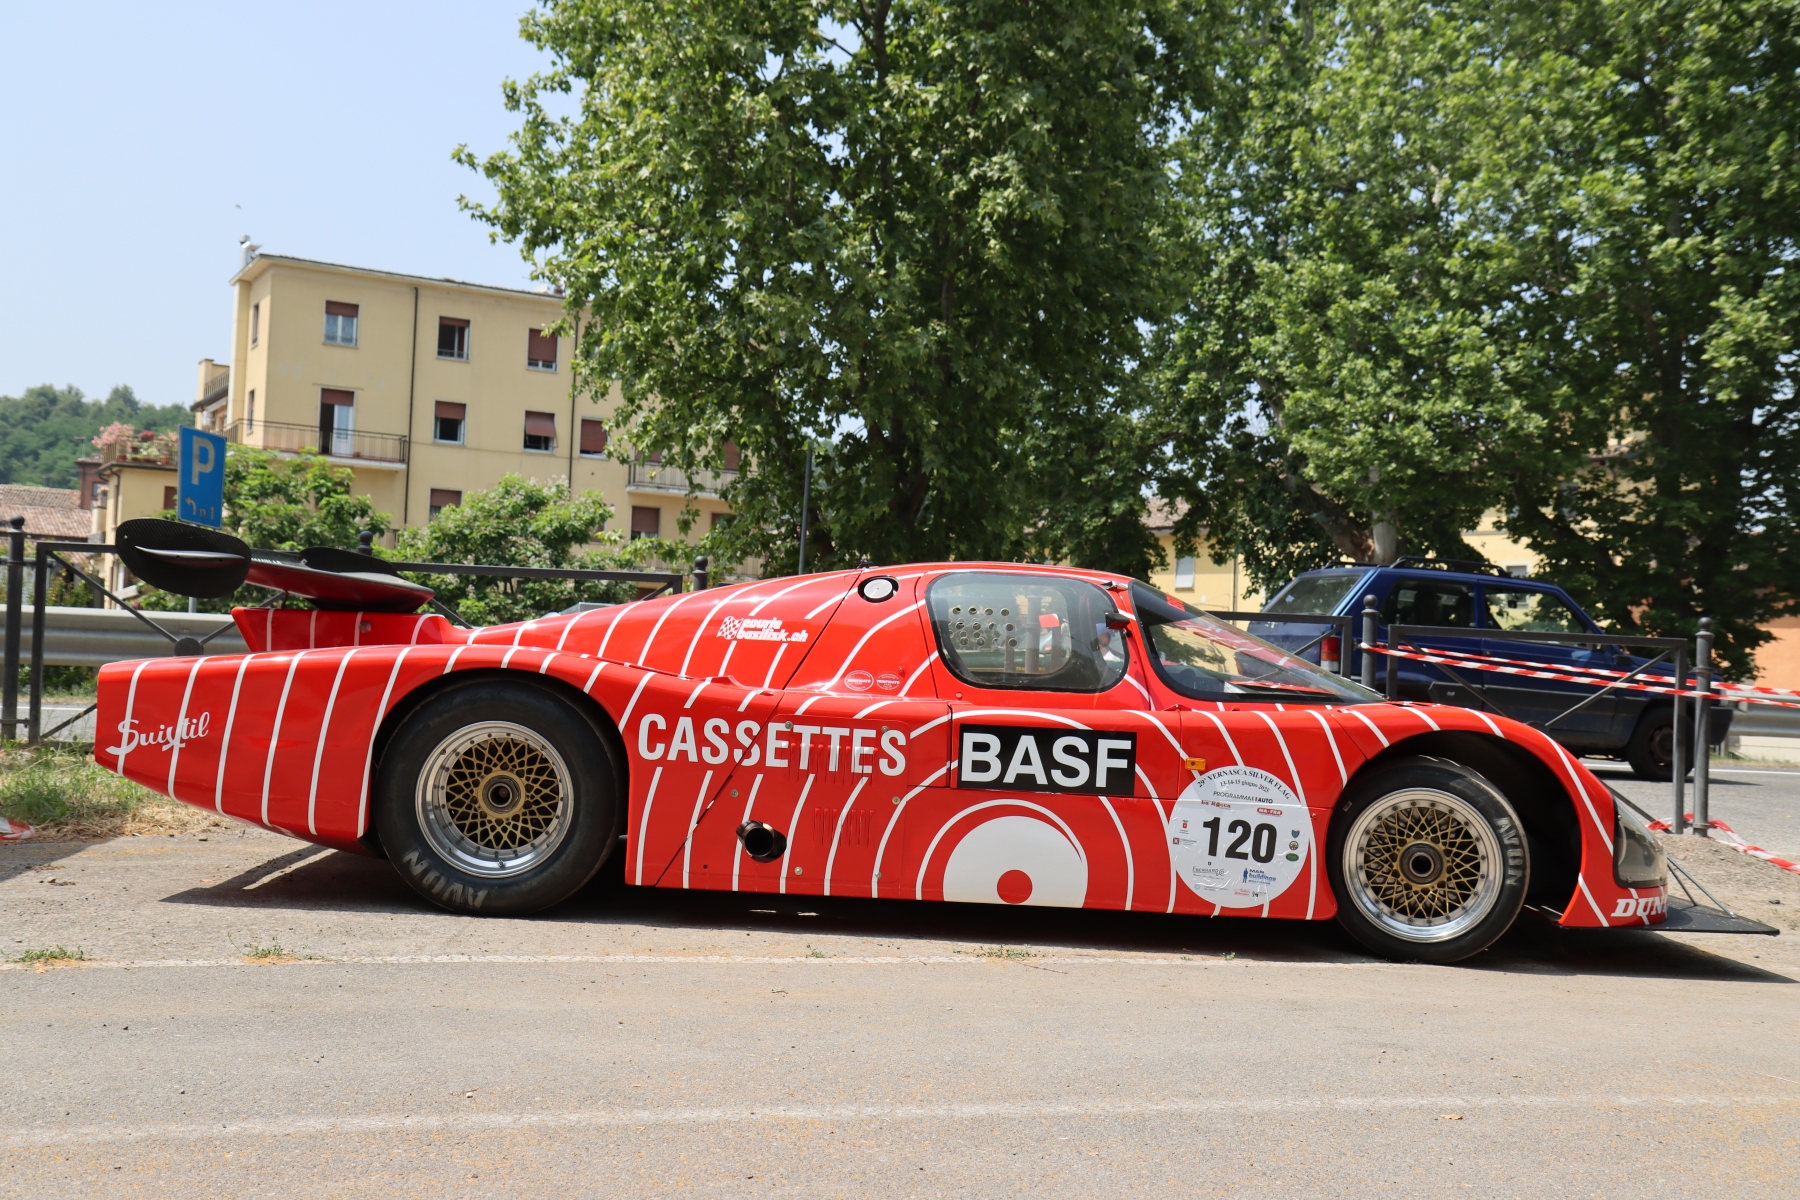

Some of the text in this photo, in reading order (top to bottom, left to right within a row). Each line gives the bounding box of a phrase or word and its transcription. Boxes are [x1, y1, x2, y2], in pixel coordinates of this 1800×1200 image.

[191, 434, 216, 486] P
[736, 628, 809, 642] basilisk.ch
[742, 617, 783, 629] ecurie
[637, 713, 907, 777] CASSETTES
[961, 731, 1133, 789] BASF
[1207, 769, 1248, 781] VERNASCA
[1248, 770, 1276, 785] SILVER
[1274, 781, 1292, 800] FLAG
[1241, 780, 1258, 789] giugno
[1258, 783, 1271, 793] 2025
[1203, 816, 1277, 863] 120
[1494, 816, 1525, 886] AVON
[402, 849, 488, 910] AVON
